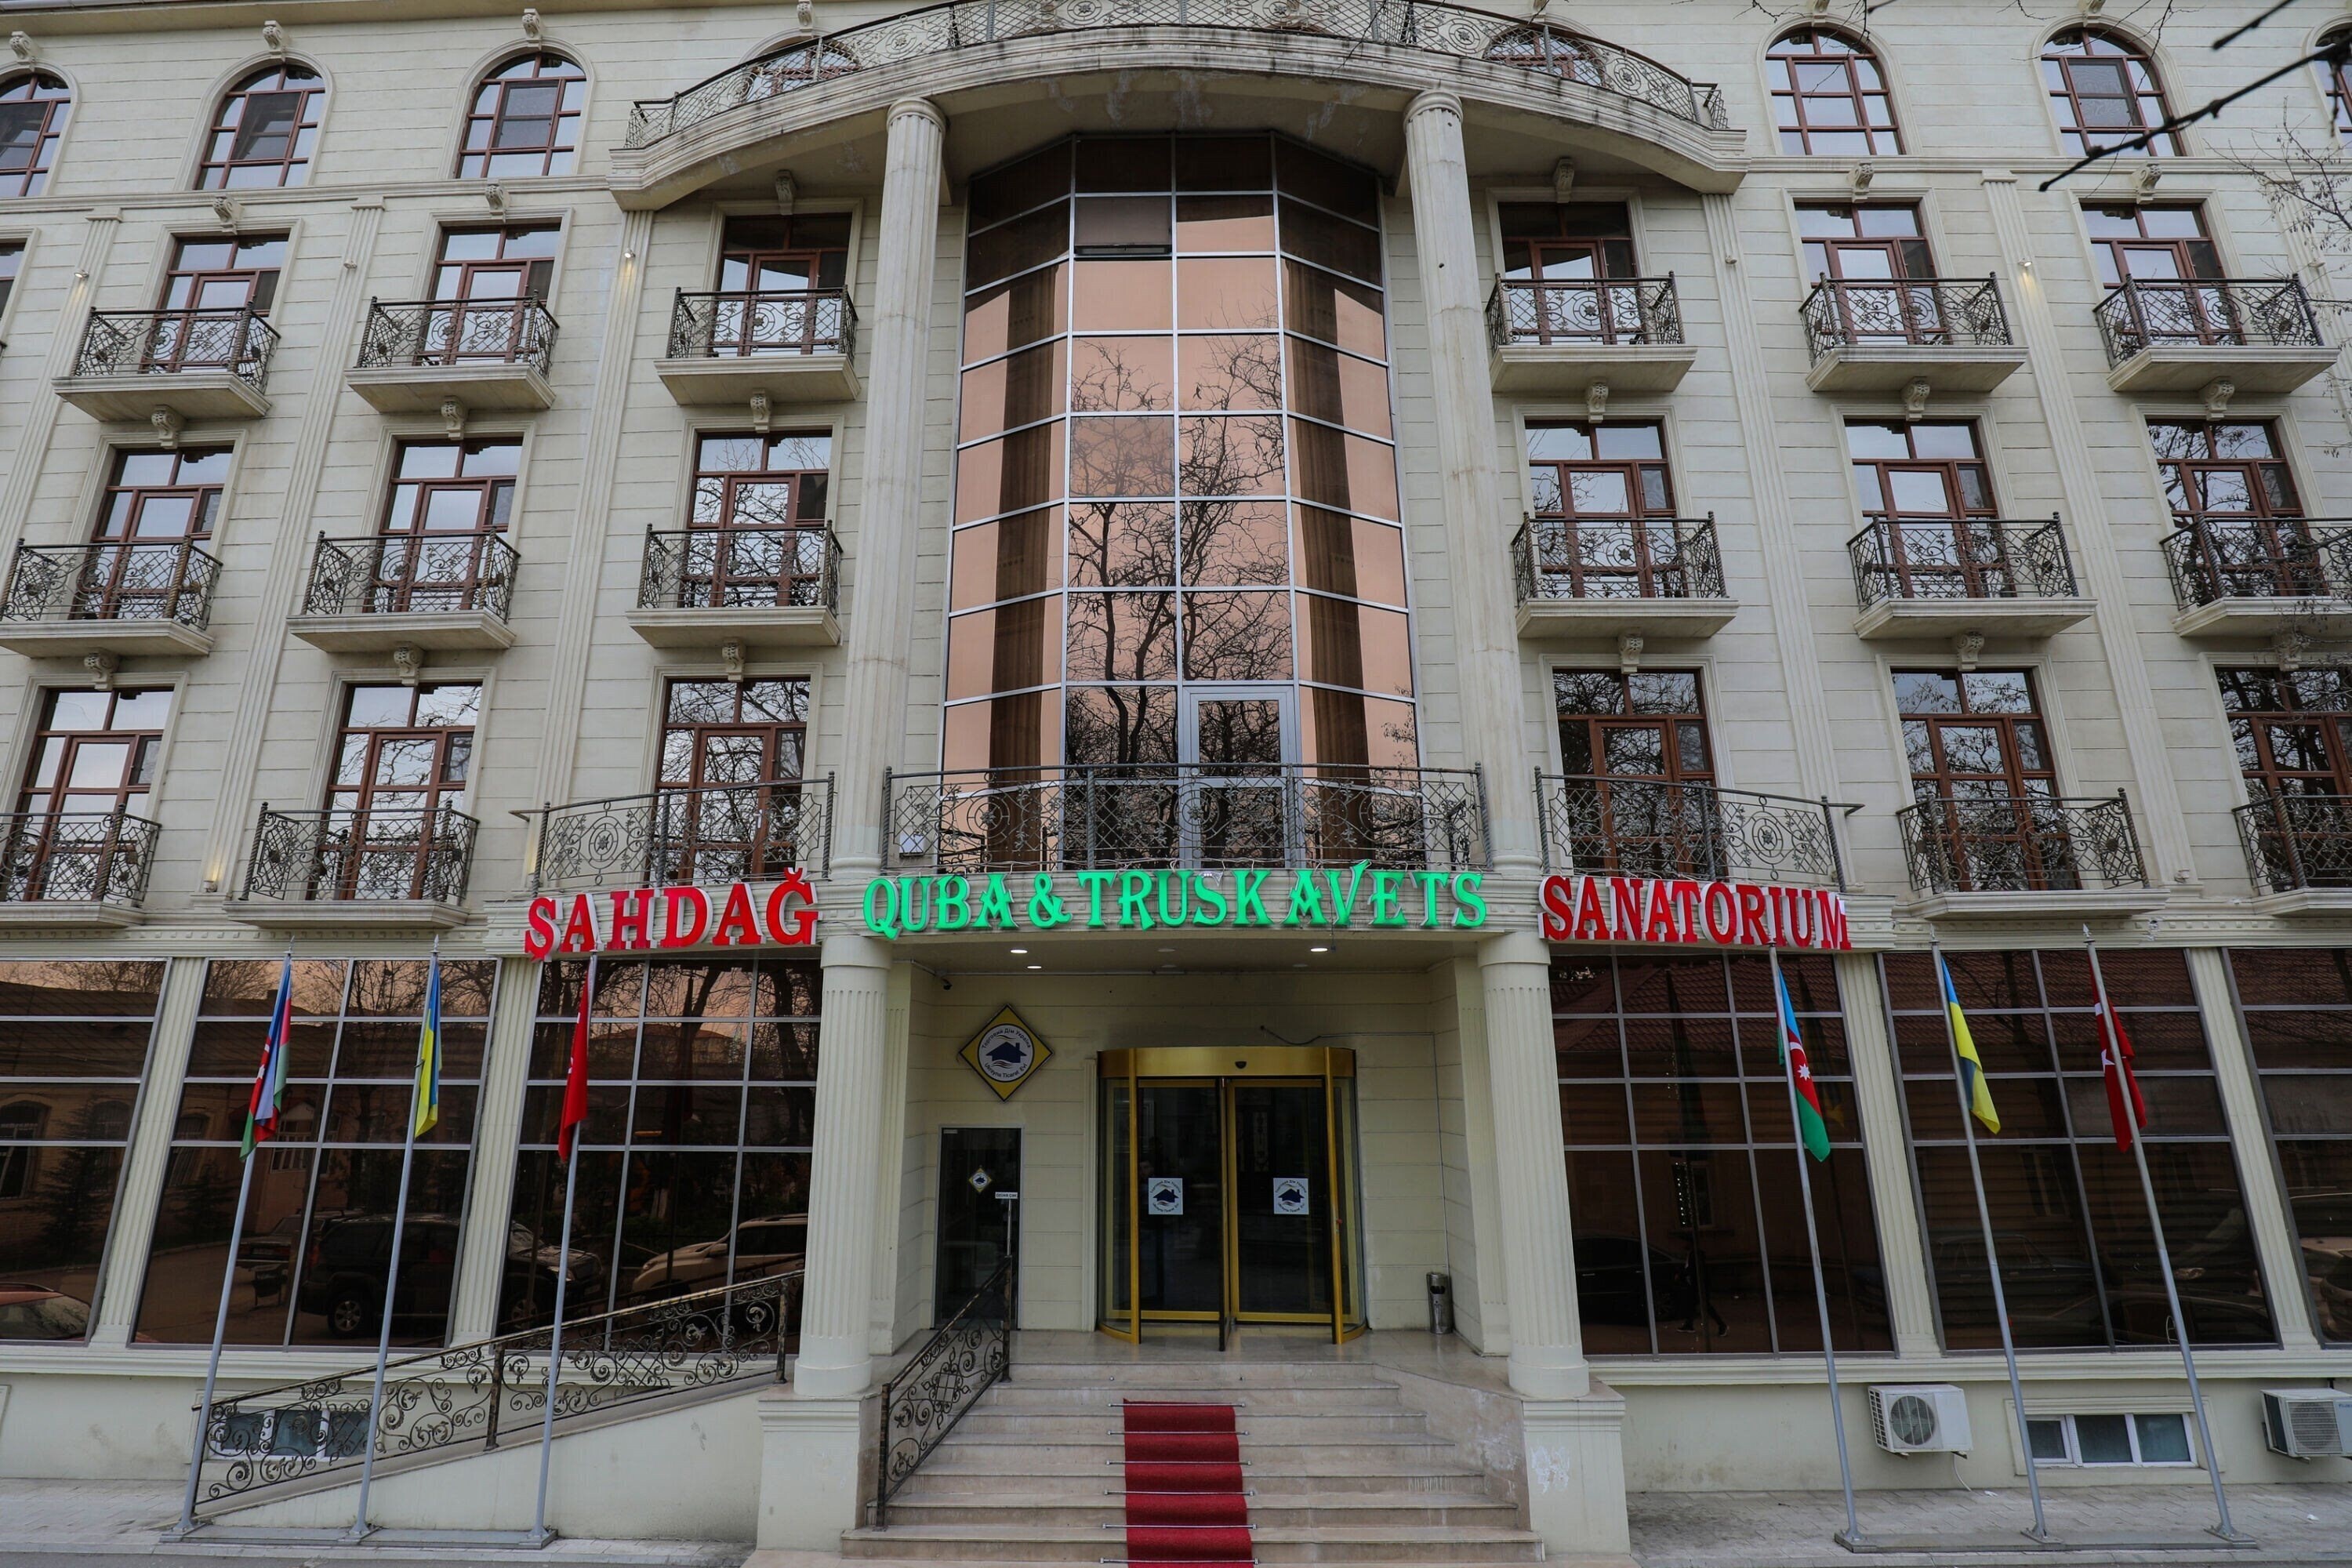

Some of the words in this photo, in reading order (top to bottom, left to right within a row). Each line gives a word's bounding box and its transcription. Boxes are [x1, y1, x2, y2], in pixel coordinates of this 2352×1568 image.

[524, 867, 821, 962] ŞAHDAĞ
[863, 872, 1019, 940] QUBA
[1028, 872, 1073, 929] &
[1076, 858, 1488, 931] TRUSKAVETS
[1538, 875, 1852, 950] SANATORIUM
